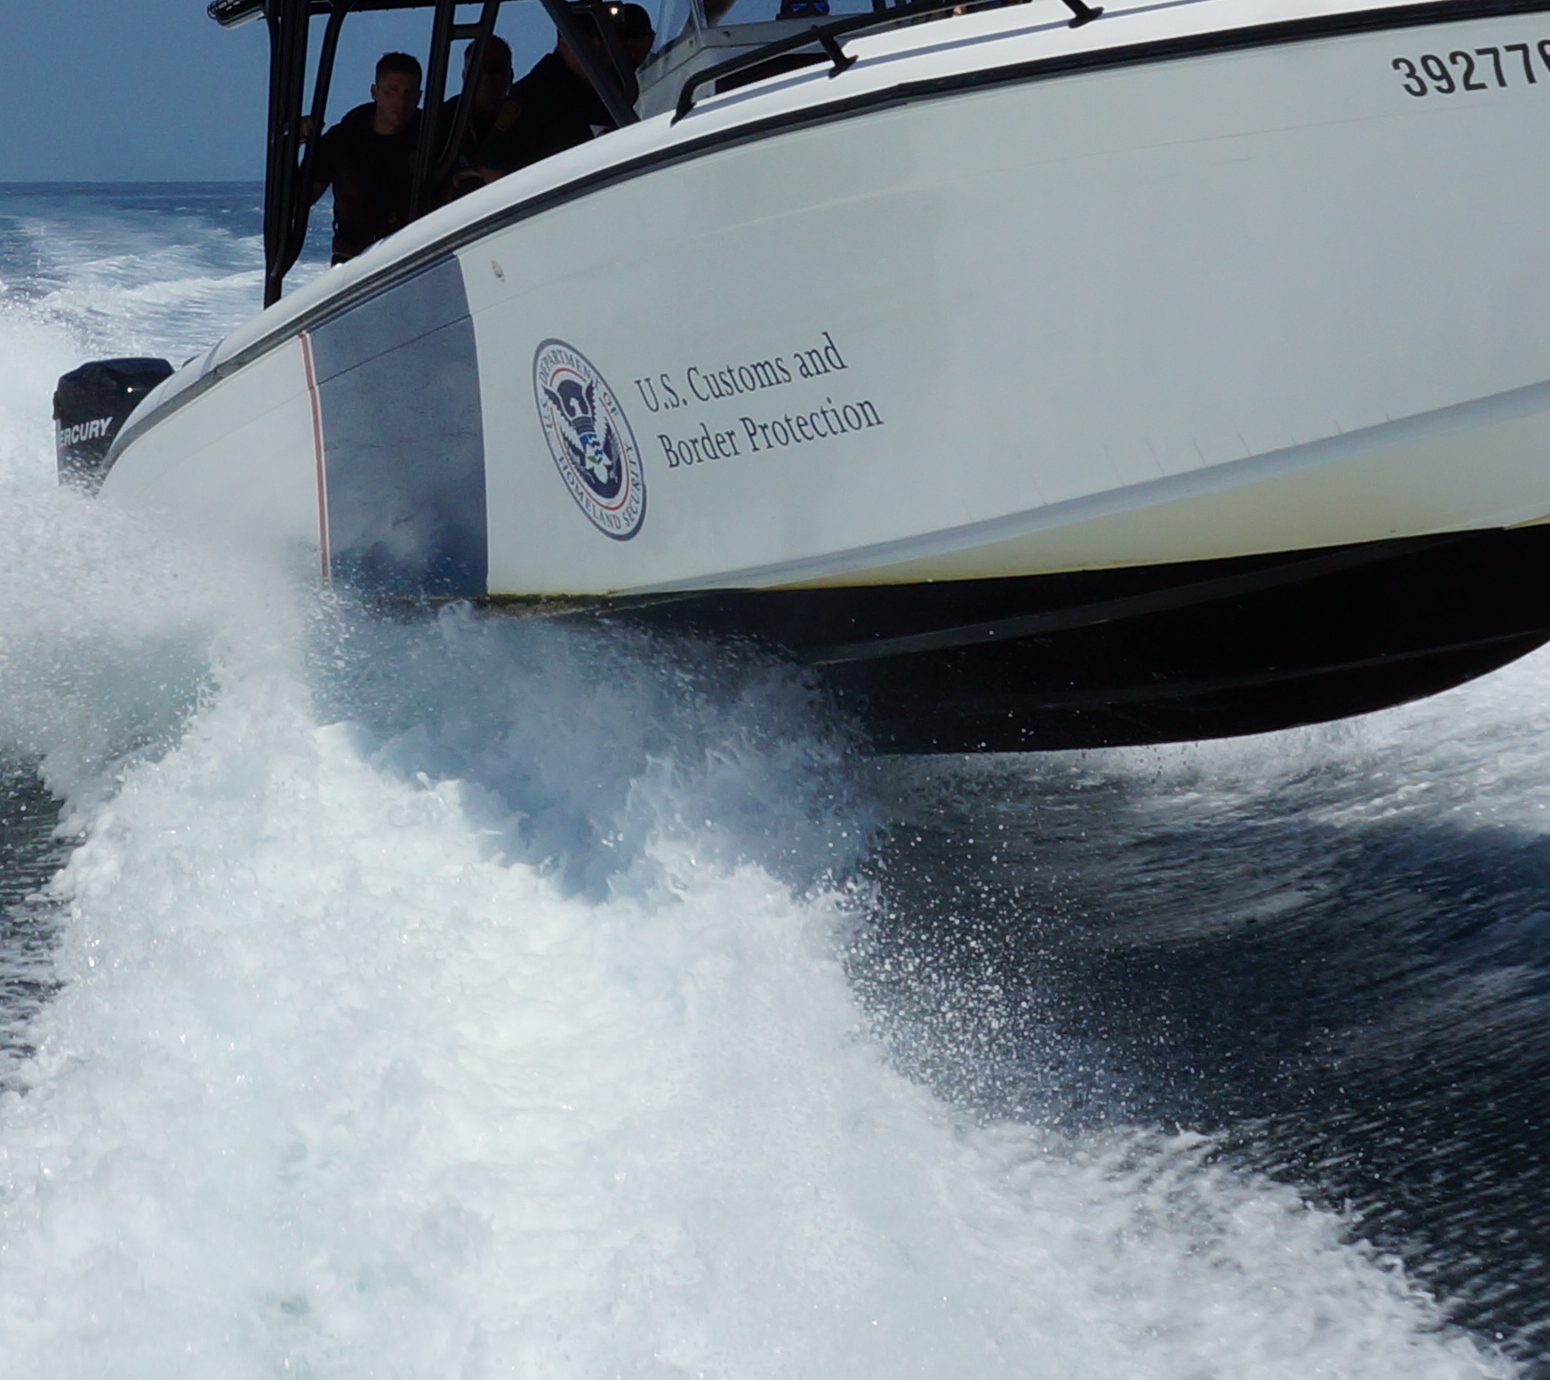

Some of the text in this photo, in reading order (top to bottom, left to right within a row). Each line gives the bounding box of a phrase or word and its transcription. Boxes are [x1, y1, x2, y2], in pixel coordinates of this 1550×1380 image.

[538, 349, 602, 389] DEPARTMENT
[634, 331, 849, 413] U.S. Customs and
[58, 416, 113, 447] ERCURY
[657, 396, 885, 469] Border Protection
[558, 455, 622, 530] HOMELAND
